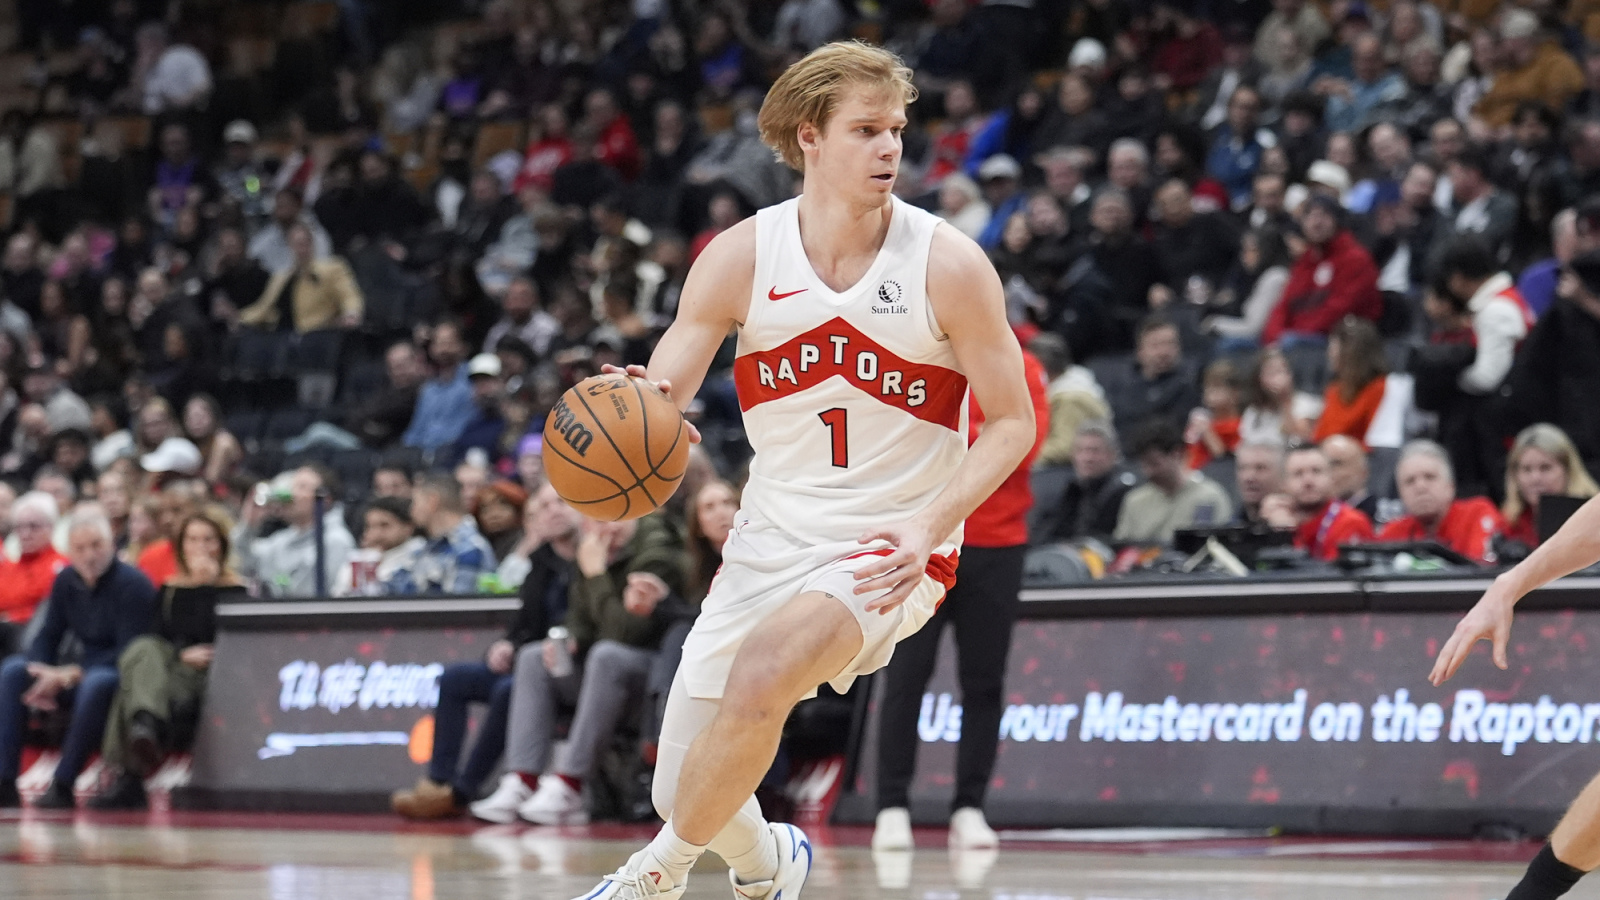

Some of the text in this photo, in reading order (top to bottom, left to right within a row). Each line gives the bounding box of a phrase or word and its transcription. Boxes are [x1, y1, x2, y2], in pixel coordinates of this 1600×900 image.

[871, 305, 908, 314] Sun Life
[757, 335, 927, 407] RAPTORS
[552, 397, 594, 459] Wilso
[818, 408, 848, 468] 1
[917, 693, 963, 742] Us
[1079, 689, 1308, 742] Mastercard
[1309, 702, 1364, 742] on
[1371, 688, 1444, 742] the
[1449, 689, 1600, 755] Raptor
